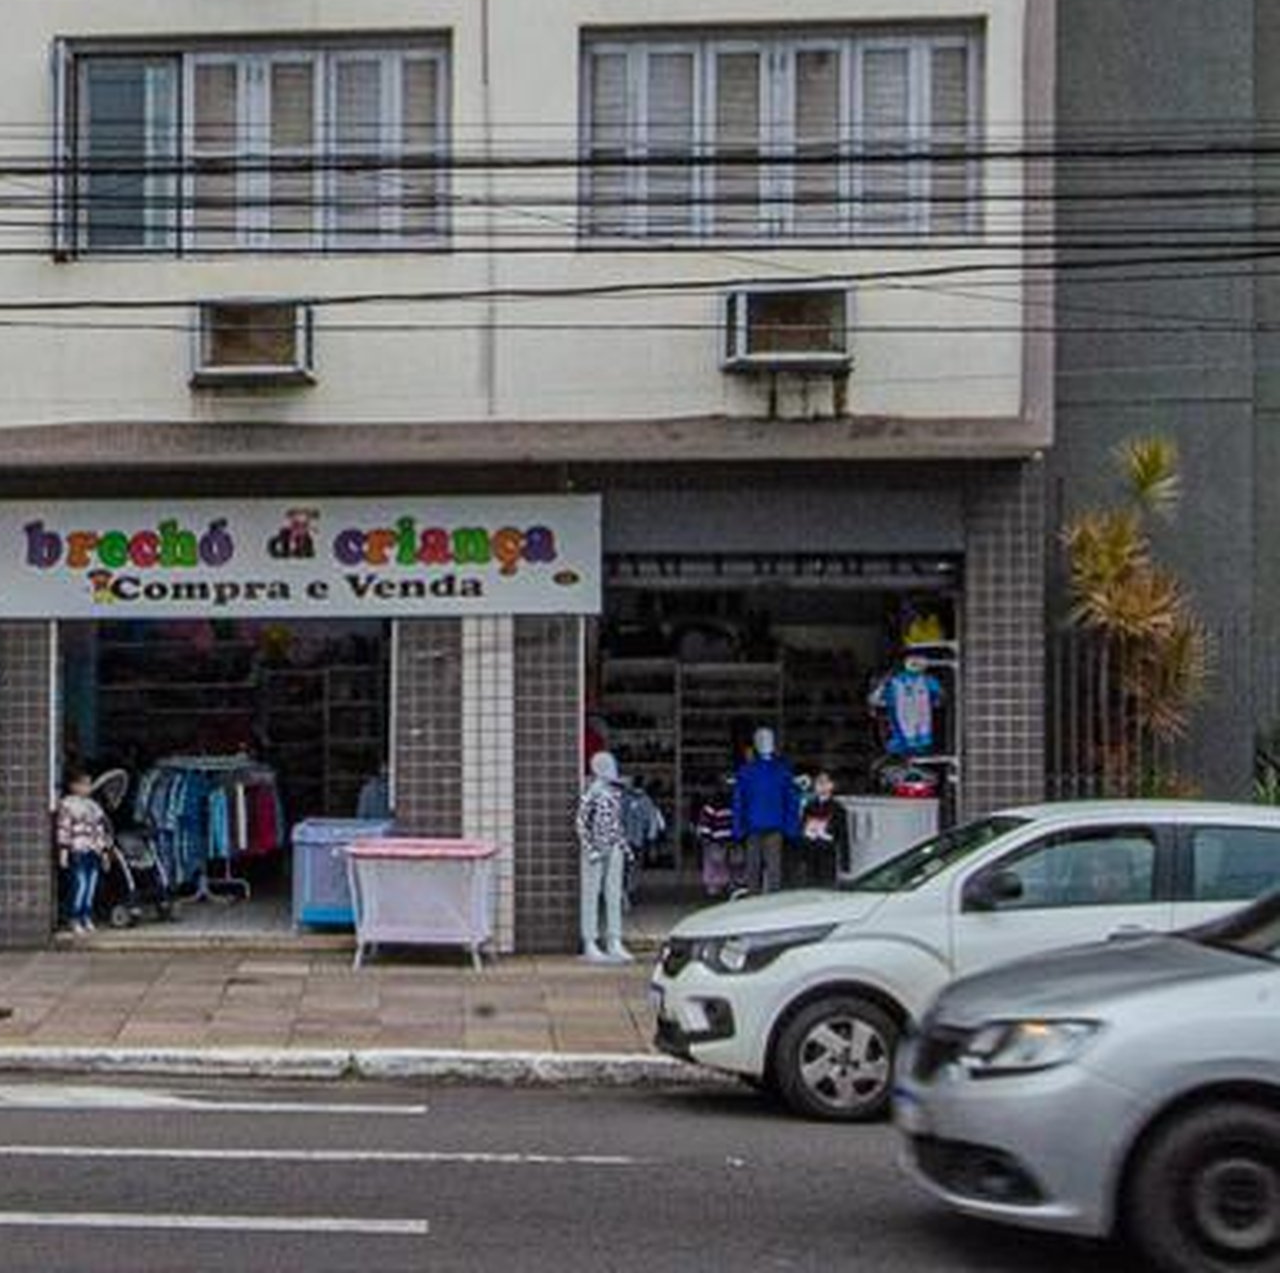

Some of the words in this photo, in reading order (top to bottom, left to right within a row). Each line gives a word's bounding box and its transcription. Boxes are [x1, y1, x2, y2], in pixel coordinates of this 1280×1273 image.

[24, 517, 234, 569] brechó
[333, 516, 557, 576] criança
[110, 576, 291, 605] Compra
[306, 581, 329, 600] e
[344, 573, 484, 601] Venda
